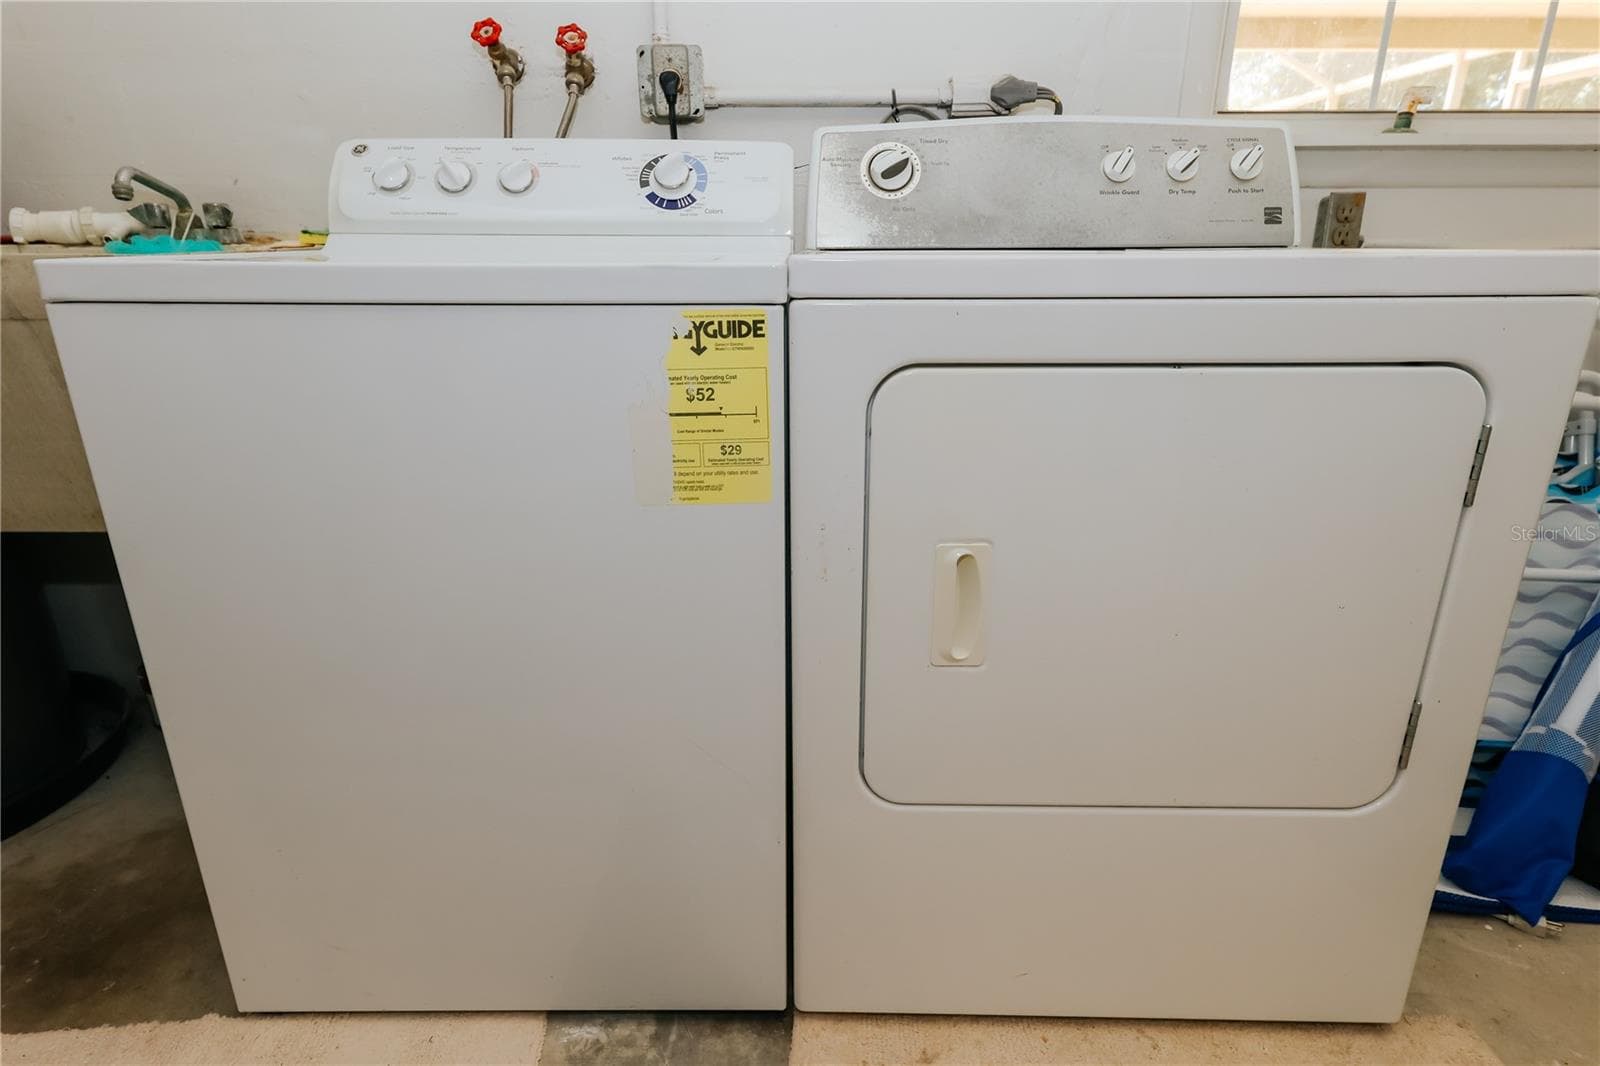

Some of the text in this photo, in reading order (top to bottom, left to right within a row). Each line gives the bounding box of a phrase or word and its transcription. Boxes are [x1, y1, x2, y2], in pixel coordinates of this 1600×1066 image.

[704, 207, 724, 215] Colors
[700, 374, 725, 382] Operating
[686, 387, 715, 403] $52
[720, 444, 742, 456] $29
